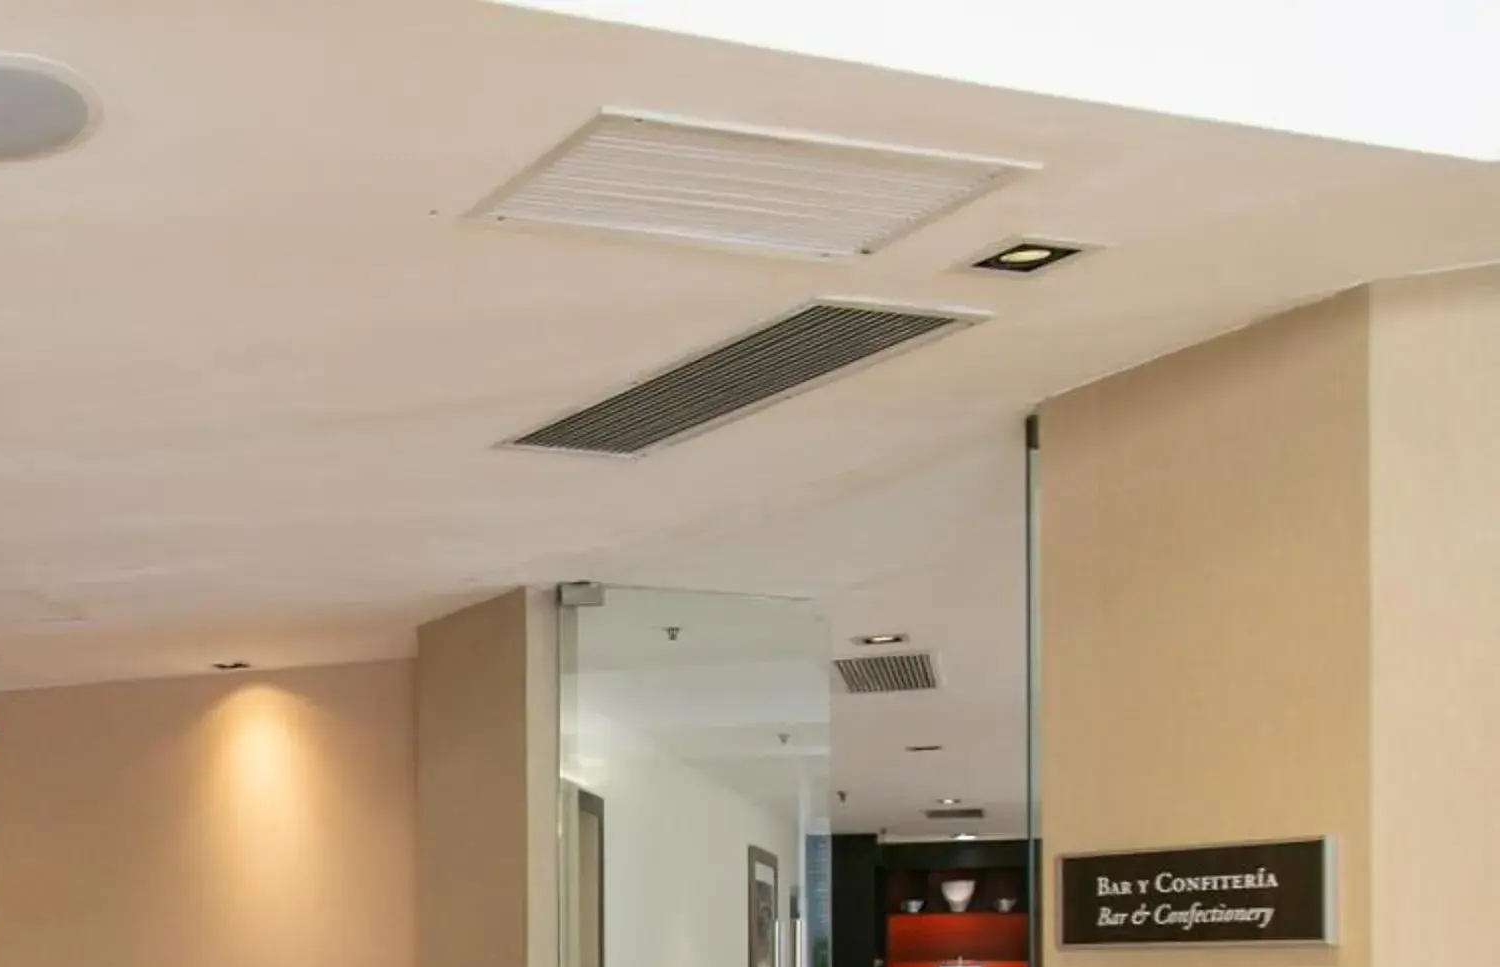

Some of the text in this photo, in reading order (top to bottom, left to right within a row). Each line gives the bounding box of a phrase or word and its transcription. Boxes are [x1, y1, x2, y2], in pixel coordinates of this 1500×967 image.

[1097, 867, 1279, 896] BAR Y CONFITERÍA
[1097, 902, 1276, 930] Bar & Confectionery
